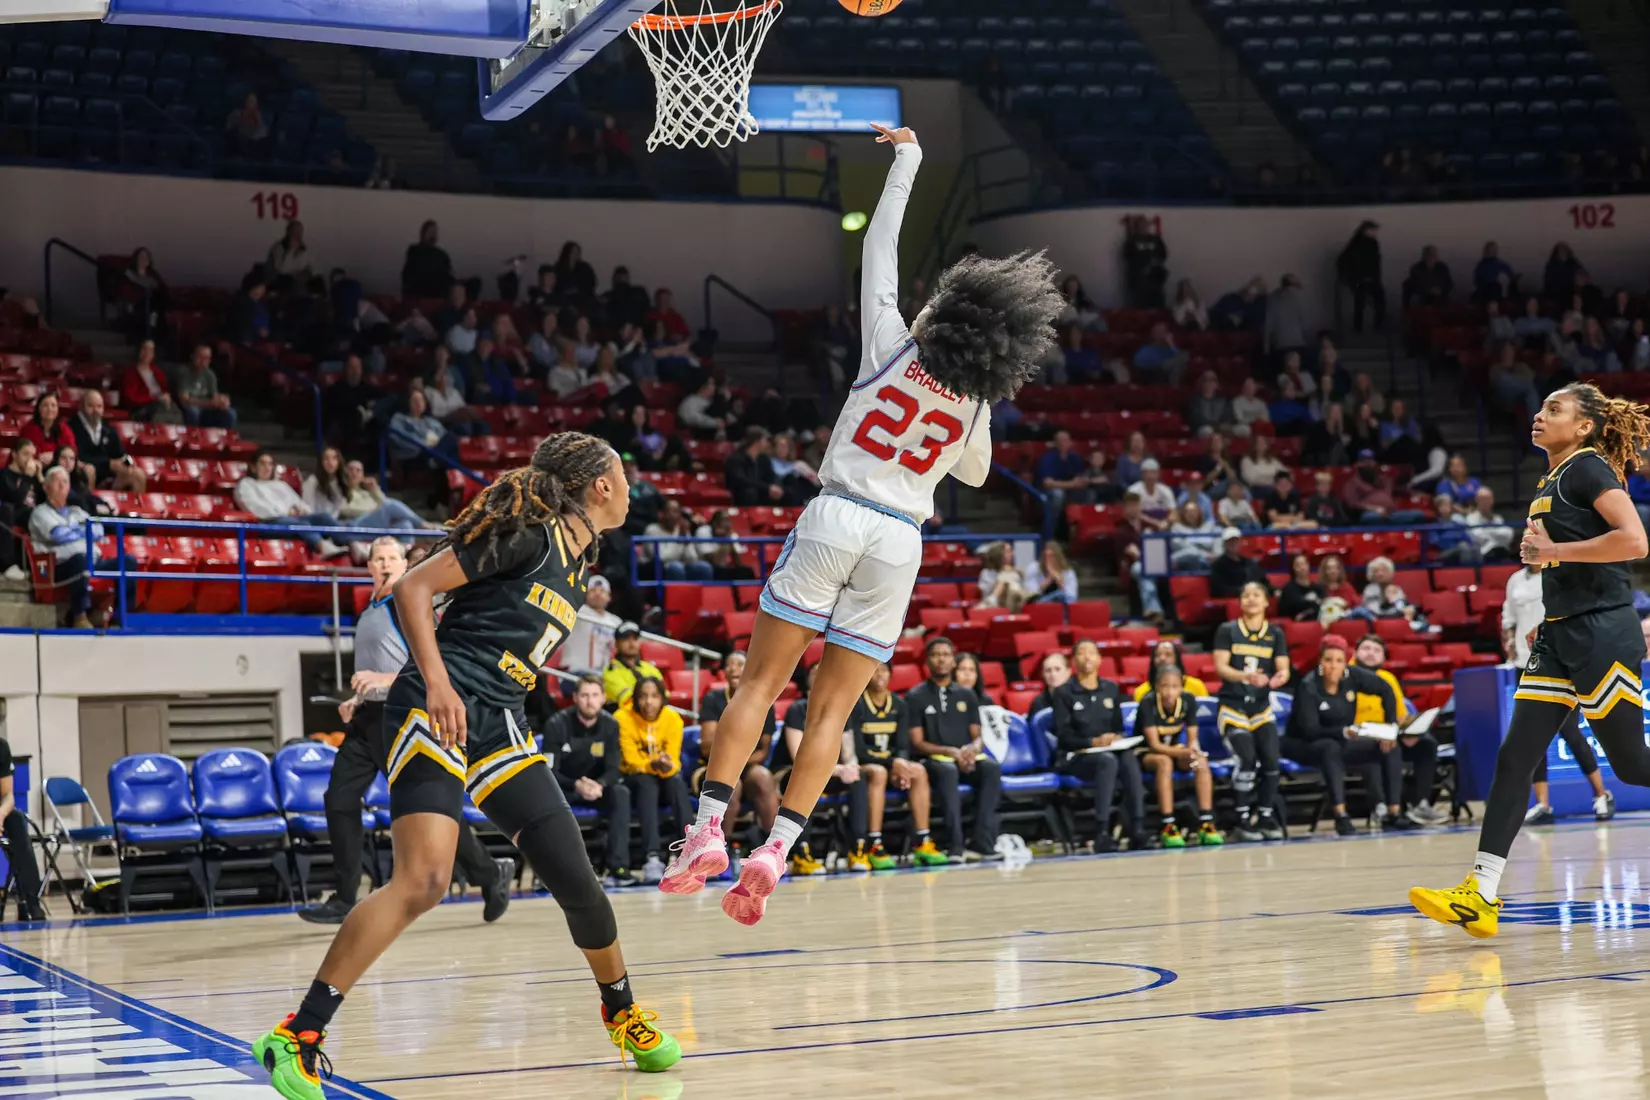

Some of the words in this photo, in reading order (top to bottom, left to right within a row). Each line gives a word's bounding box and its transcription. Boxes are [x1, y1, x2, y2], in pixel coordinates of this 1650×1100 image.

[249, 191, 299, 220] 119
[1568, 203, 1615, 230] 102
[851, 383, 964, 476] 23
[874, 733, 890, 752] 4
